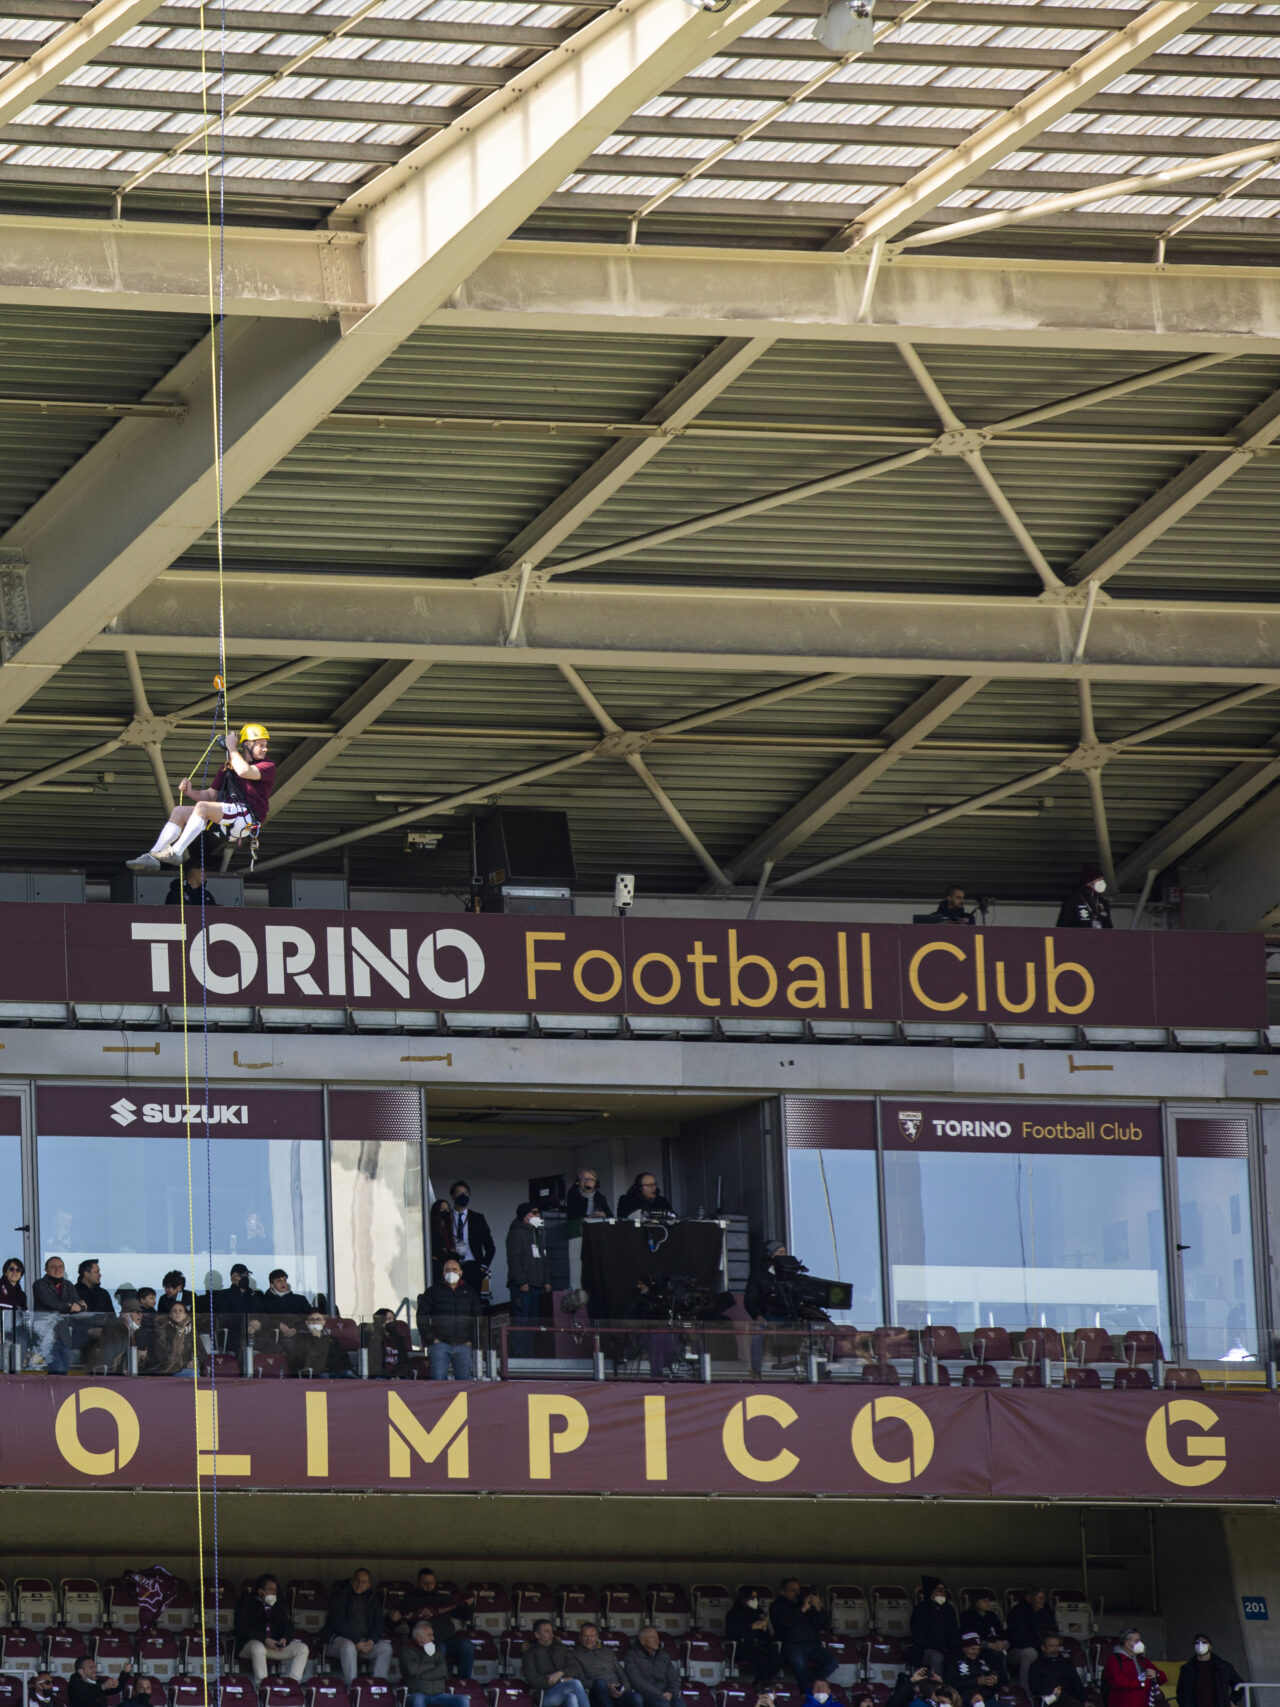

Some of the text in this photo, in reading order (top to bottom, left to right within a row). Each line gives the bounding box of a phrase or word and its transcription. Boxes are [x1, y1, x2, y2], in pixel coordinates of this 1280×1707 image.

[131, 922, 1095, 1015] TORINO Football Club
[142, 1103, 249, 1124] SUZUKI
[932, 1119, 1142, 1141] TORINO Football Club
[55, 1386, 934, 1484] OLIMPICO
[1146, 1399, 1227, 1486] G
[1245, 1602, 1266, 1613] 201
